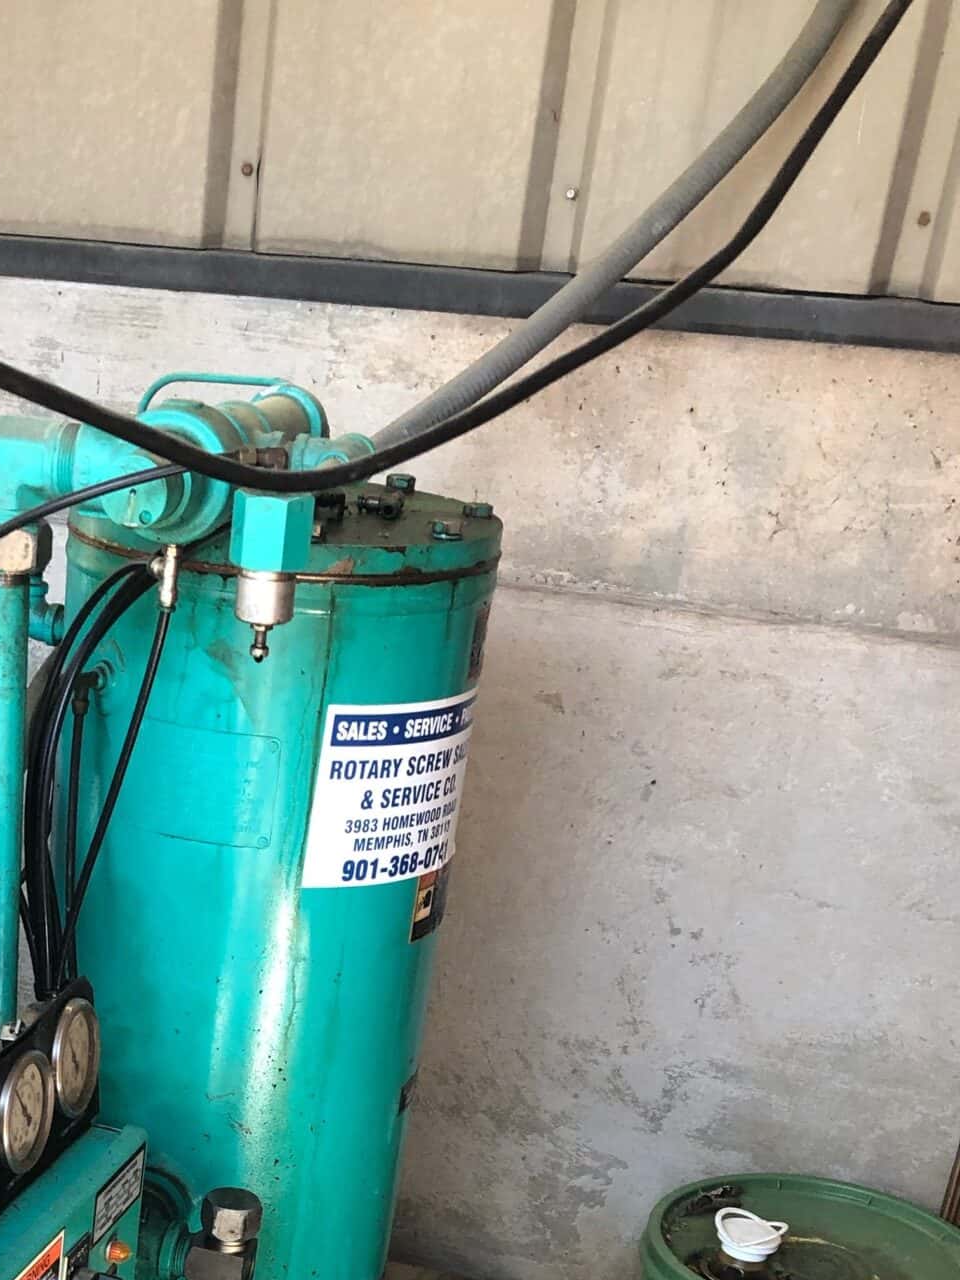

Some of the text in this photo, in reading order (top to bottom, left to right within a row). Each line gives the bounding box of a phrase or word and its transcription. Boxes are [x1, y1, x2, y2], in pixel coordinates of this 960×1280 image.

[336, 720, 388, 741] SALES
[404, 712, 453, 739] SERVICE
[330, 758, 403, 780] ROTARY
[406, 747, 453, 777] SCREW
[360, 789, 374, 810] &
[380, 779, 442, 809] SERVICE
[344, 818, 378, 834] 3983
[382, 806, 442, 831] HOMEWOOD
[353, 831, 414, 852] MEMPHIS,
[417, 828, 429, 843] TN
